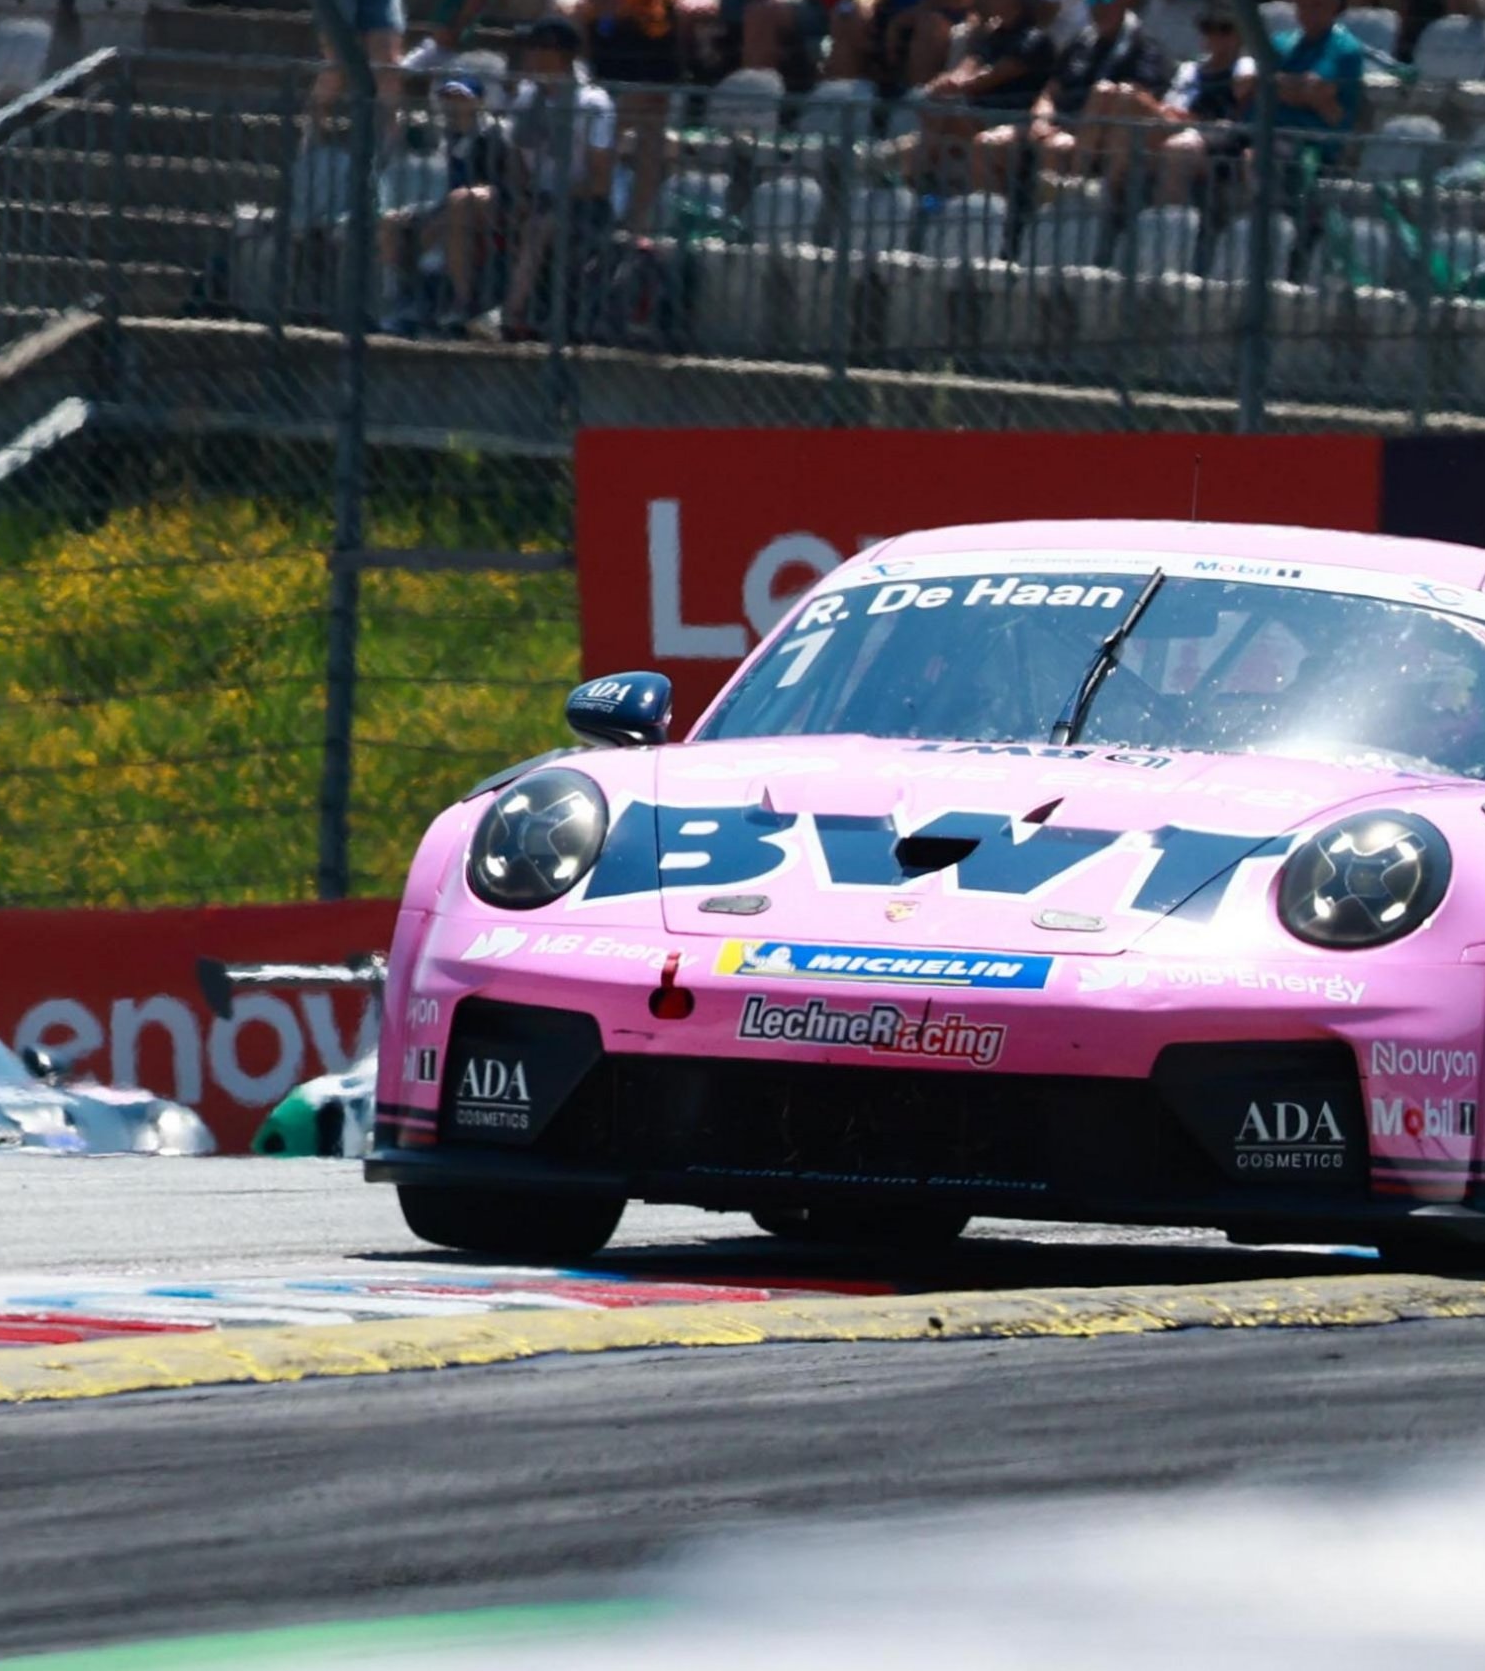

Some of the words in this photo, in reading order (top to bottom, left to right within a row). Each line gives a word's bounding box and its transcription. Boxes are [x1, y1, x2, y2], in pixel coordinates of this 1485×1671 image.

[795, 594, 849, 632] R.
[868, 583, 950, 612] De
[962, 577, 1124, 610] Haan
[581, 681, 633, 702] ADA
[569, 795, 1301, 924] BWT
[530, 933, 577, 956] MB
[582, 936, 701, 970] Energy
[805, 954, 1025, 979] MICHELIN
[1236, 966, 1366, 1004] Energy
[456, 1057, 532, 1102] ADA
[1370, 1040, 1477, 1084] Nouryon
[455, 1110, 530, 1130] COSMETICS
[1234, 1100, 1346, 1143] ADA
[1370, 1098, 1454, 1138] Mobil
[1458, 1101, 1476, 1137] 1
[1235, 1152, 1344, 1169] COSMETICS
